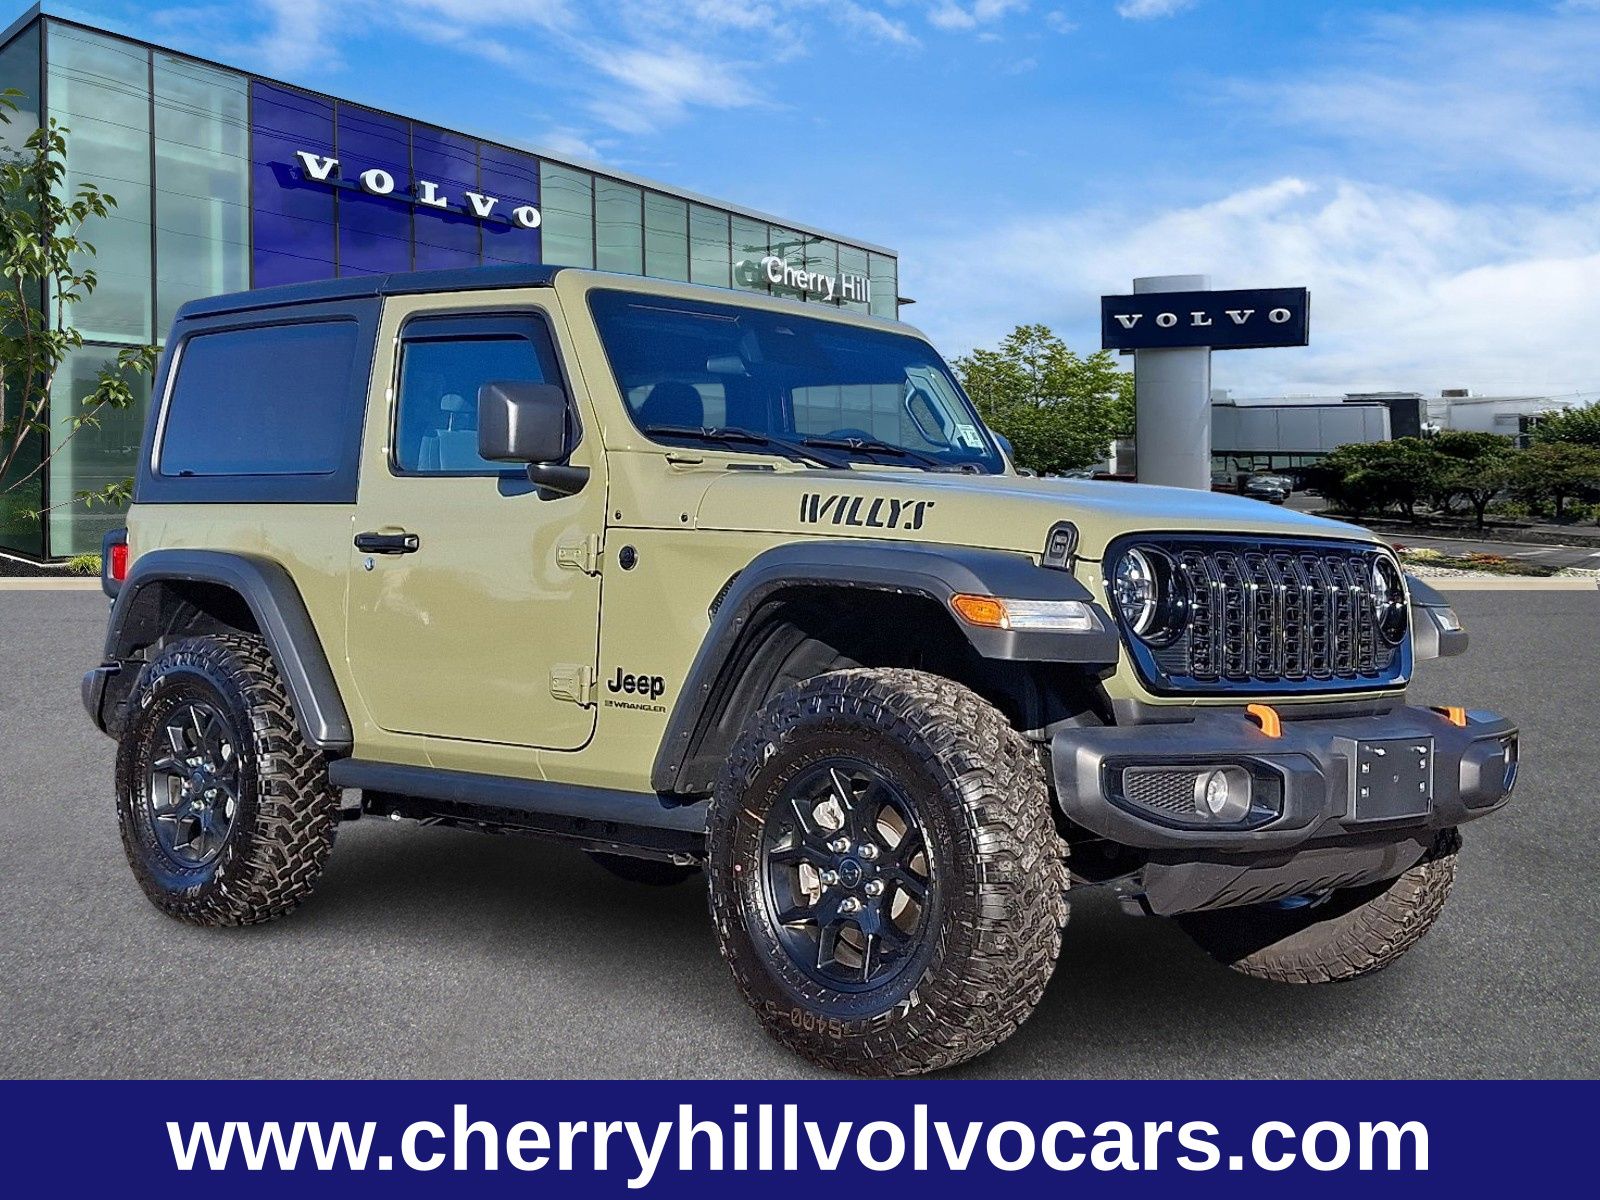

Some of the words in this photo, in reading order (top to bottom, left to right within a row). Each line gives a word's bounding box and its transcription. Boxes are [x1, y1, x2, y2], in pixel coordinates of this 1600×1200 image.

[296, 150, 542, 229] VOLVO
[764, 256, 836, 301] Cherry
[840, 273, 871, 302] Hill
[1114, 308, 1291, 329] VOLVO
[800, 493, 935, 530] WILLYS
[607, 667, 666, 700] Jeep
[613, 701, 666, 713] WRANGLER
